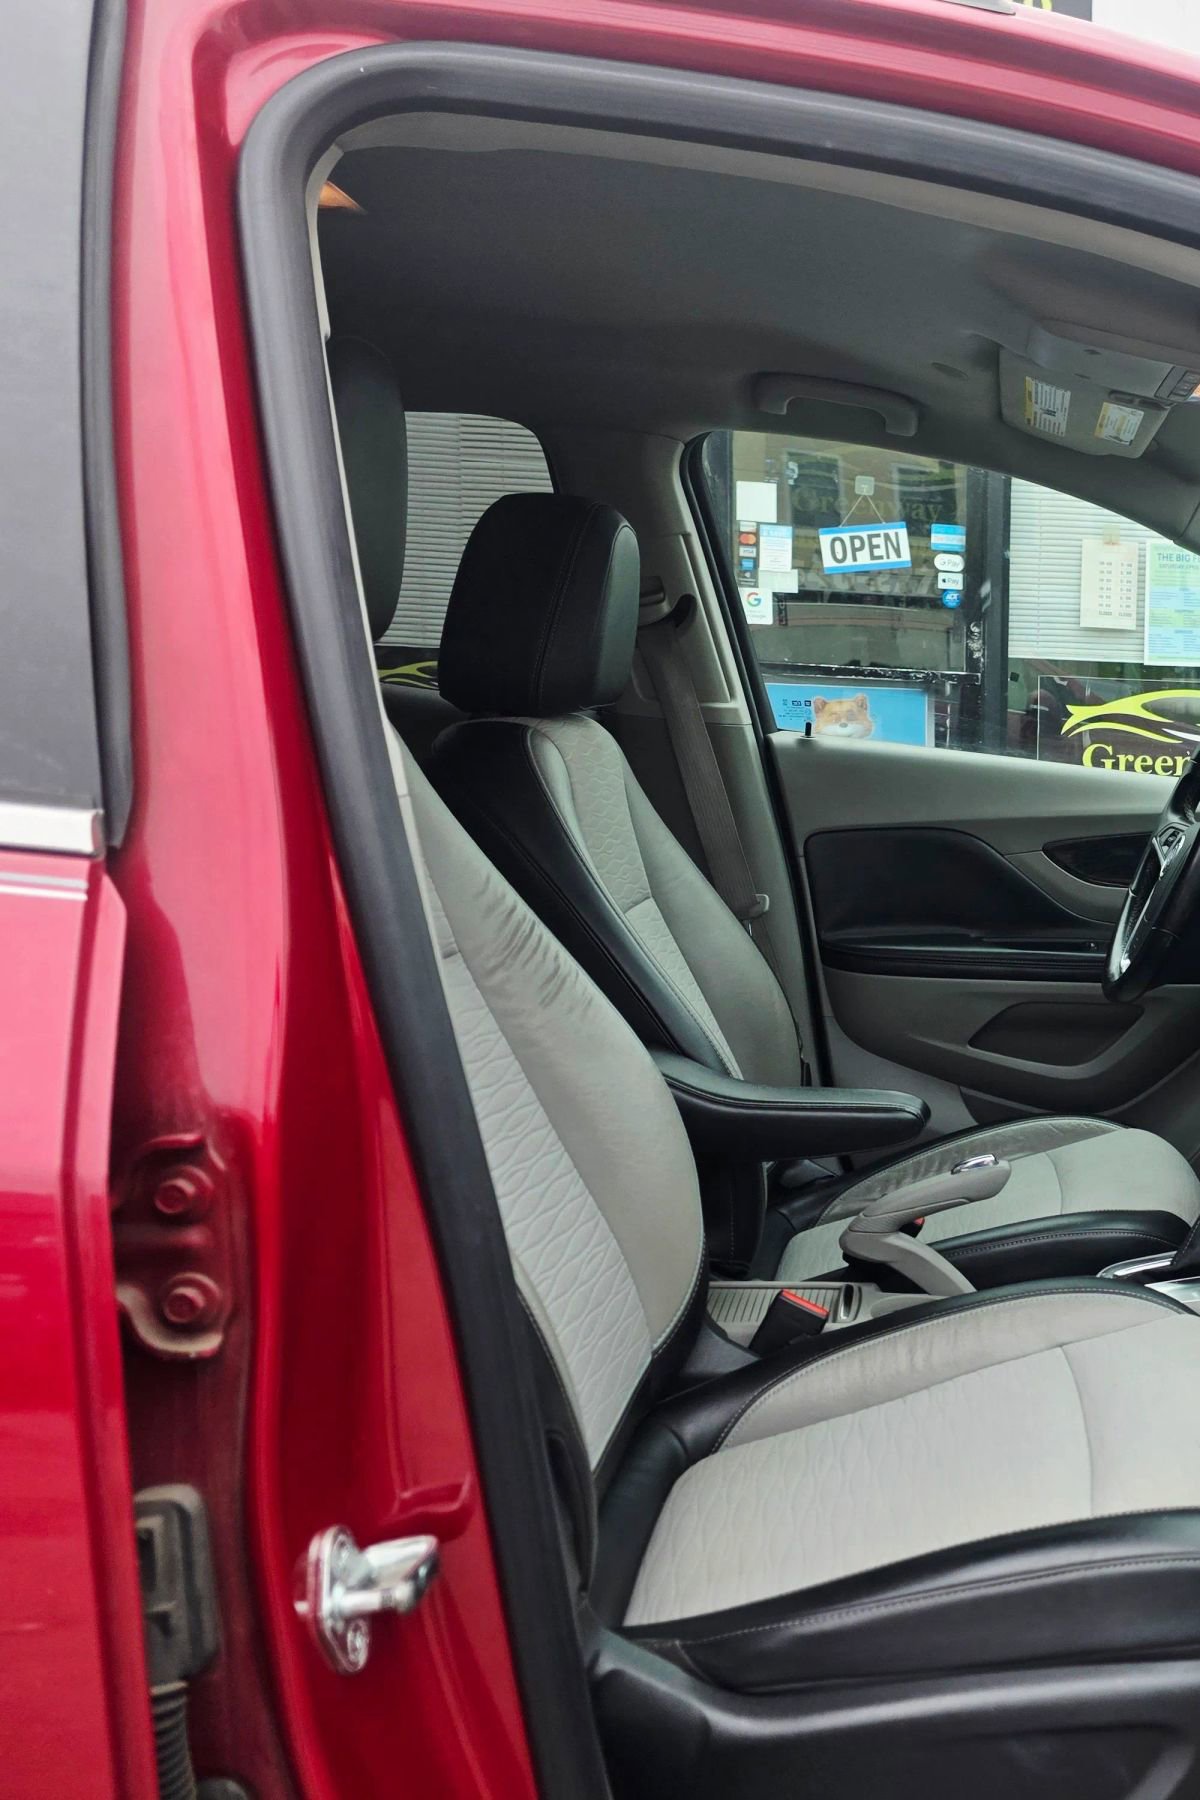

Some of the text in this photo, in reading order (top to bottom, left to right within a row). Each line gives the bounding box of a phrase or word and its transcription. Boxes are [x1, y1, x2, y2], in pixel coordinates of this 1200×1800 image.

[829, 531, 902, 564] OPEN
[1157, 552, 1174, 562] THE
[1176, 553, 1191, 563] BIG
